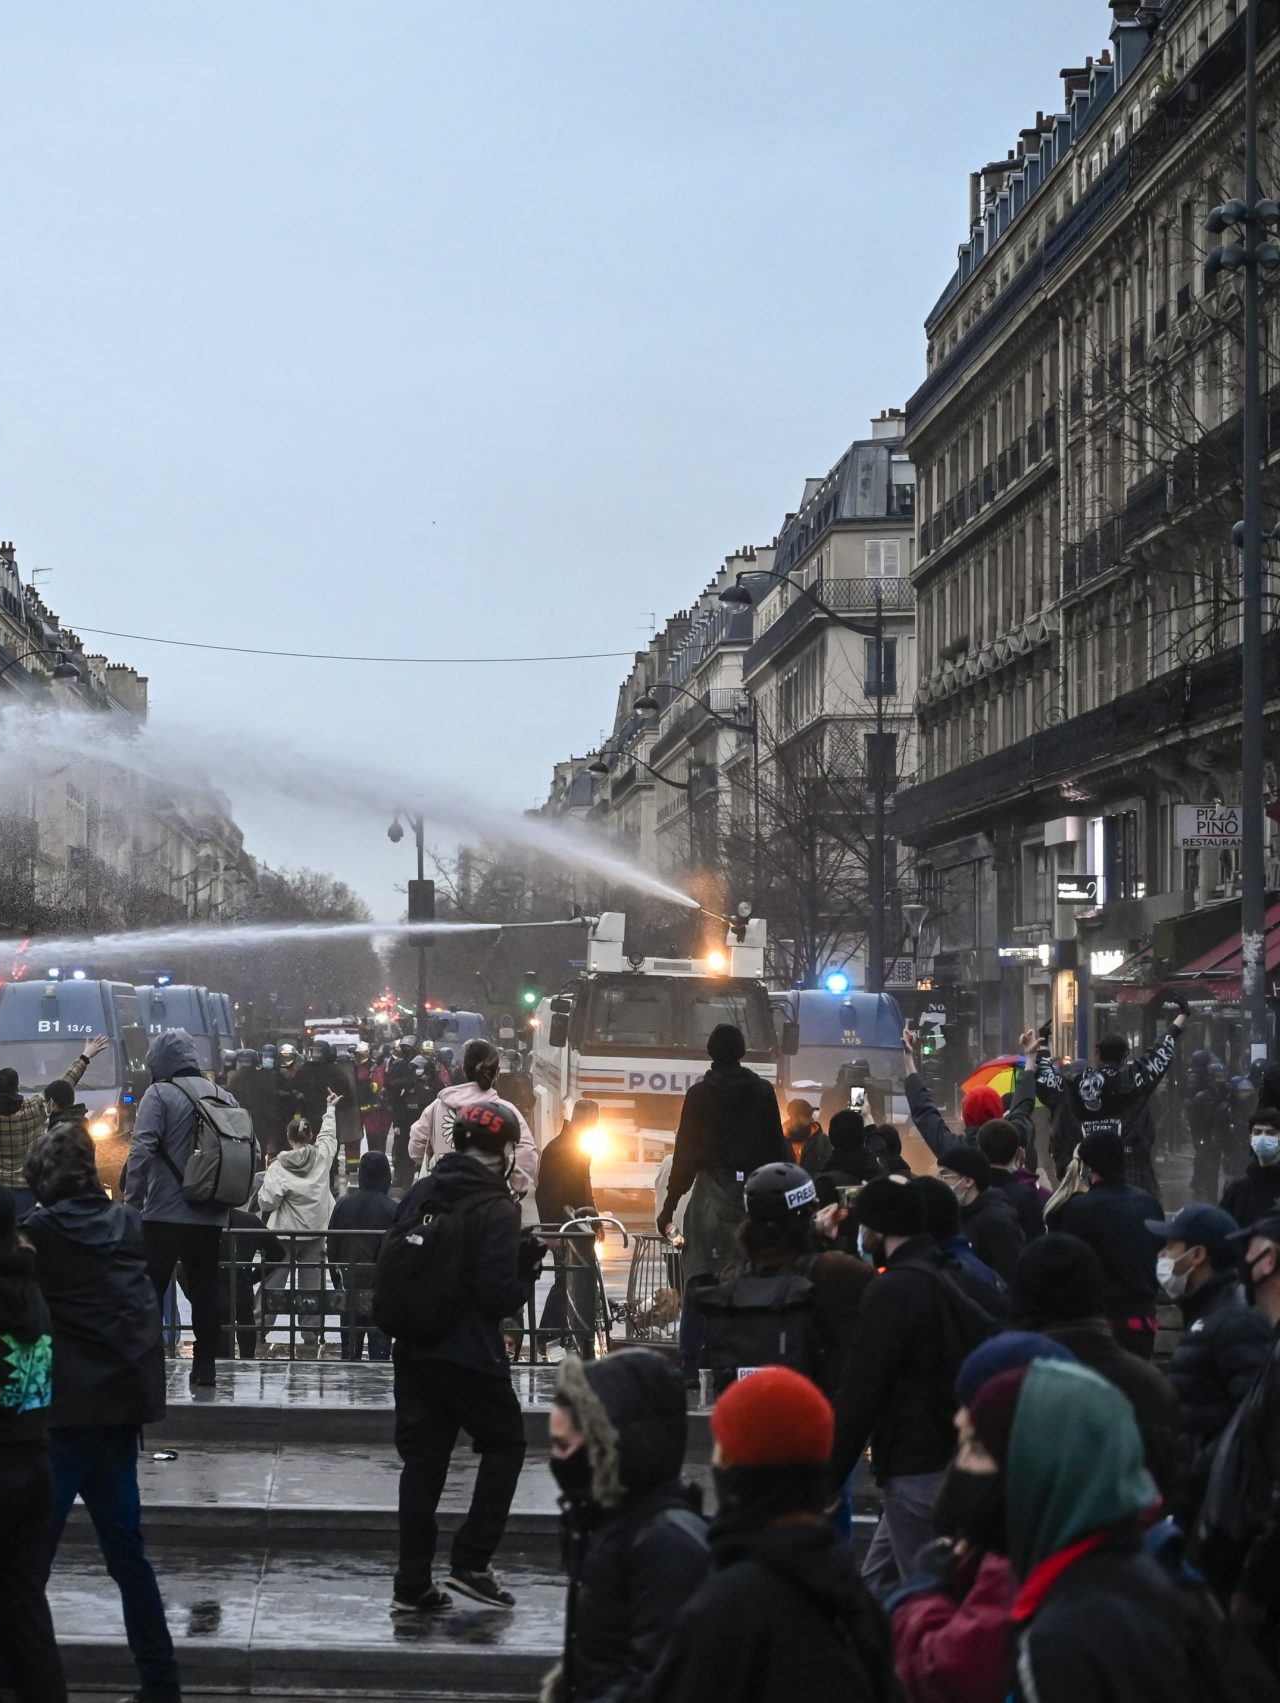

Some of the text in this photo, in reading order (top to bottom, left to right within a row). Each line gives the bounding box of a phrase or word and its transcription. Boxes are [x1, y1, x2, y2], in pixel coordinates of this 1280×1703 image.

[1197, 821, 1239, 834] PINO
[1182, 838, 1244, 847] RESTAURAN
[38, 1020, 93, 1033] B1 13/5
[628, 1072, 706, 1092] POLI
[788, 1184, 816, 1206] PRES
